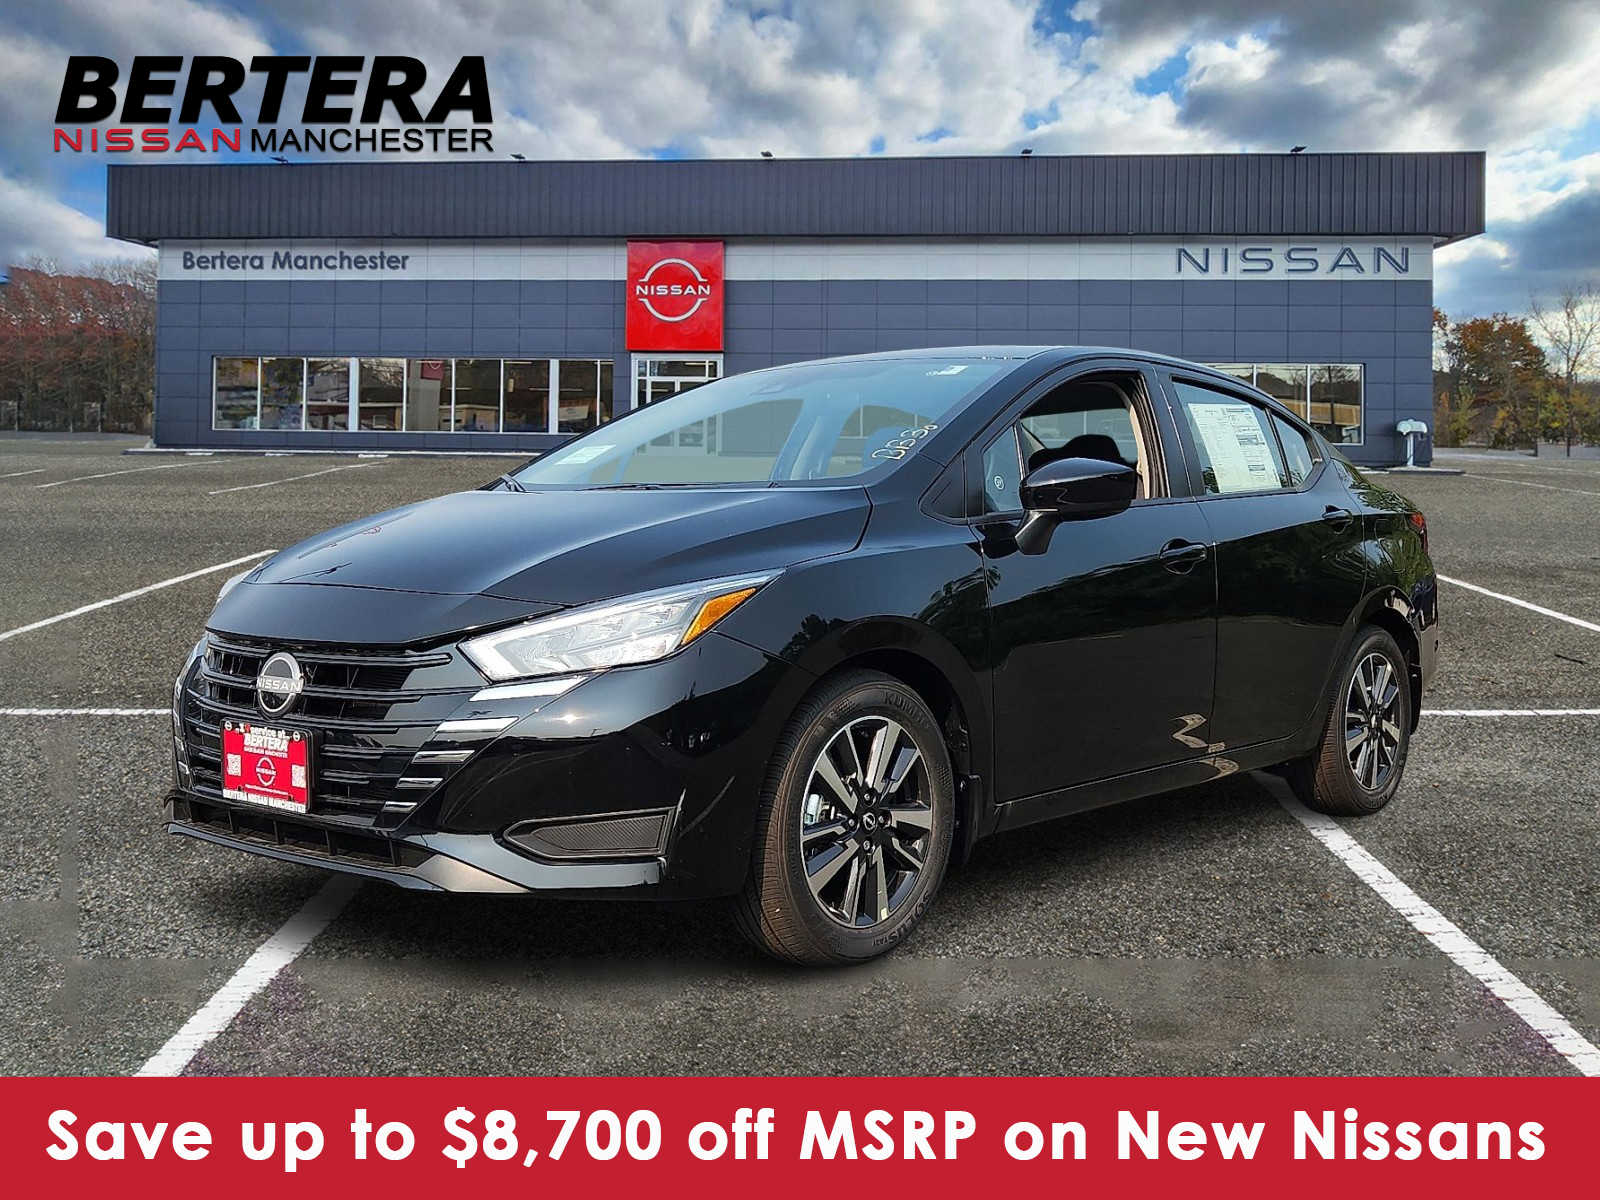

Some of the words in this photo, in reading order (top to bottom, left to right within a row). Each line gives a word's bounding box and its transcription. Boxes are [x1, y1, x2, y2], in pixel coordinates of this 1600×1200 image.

[182, 250, 265, 270] Bertera
[271, 250, 410, 270] Manchester
[1176, 247, 1410, 274] NISSAN
[636, 285, 711, 295] NISSAN
[257, 678, 302, 693] NISSAN
[244, 733, 288, 752] BERTERA
